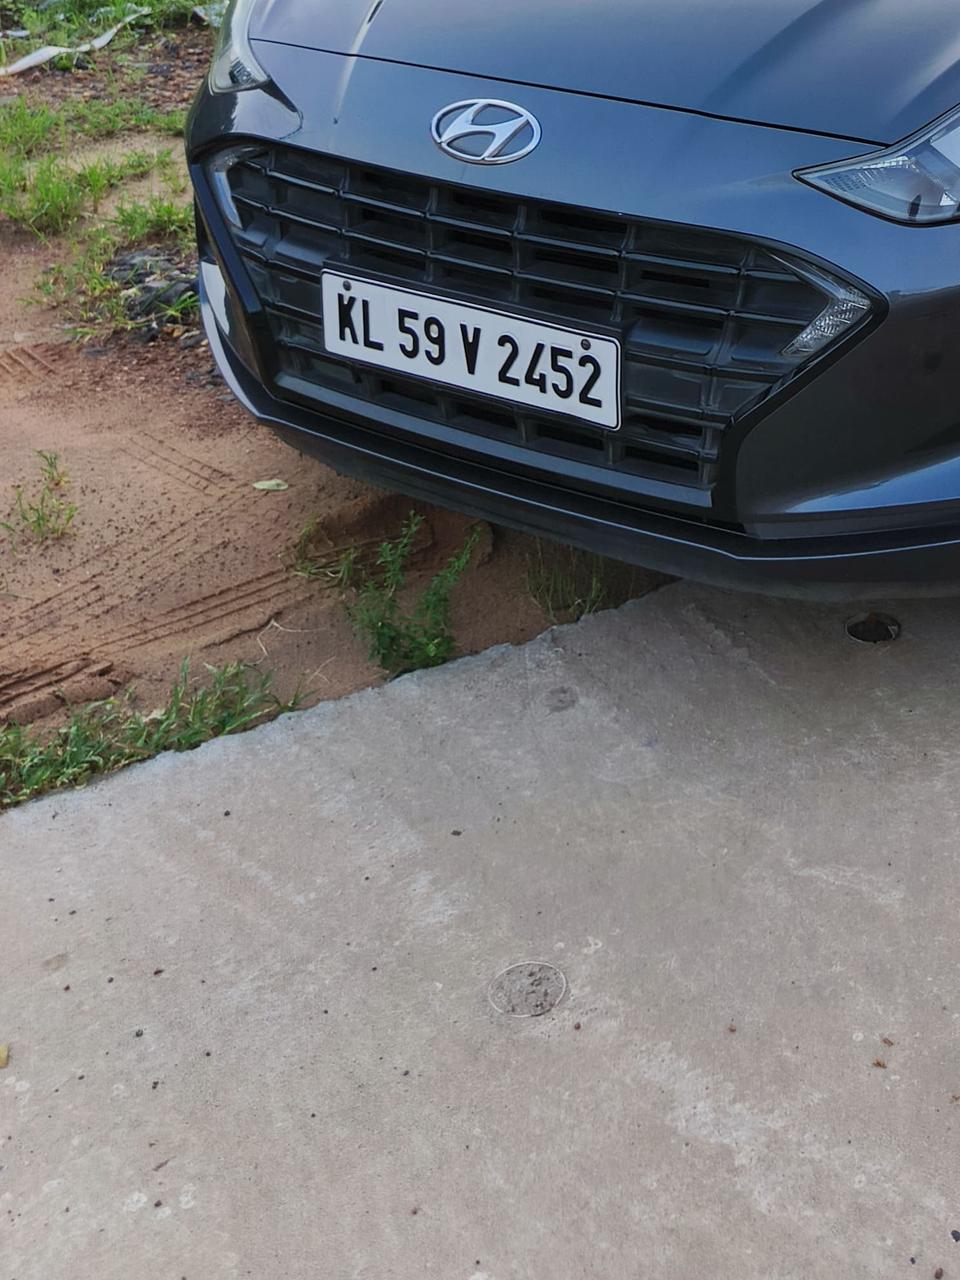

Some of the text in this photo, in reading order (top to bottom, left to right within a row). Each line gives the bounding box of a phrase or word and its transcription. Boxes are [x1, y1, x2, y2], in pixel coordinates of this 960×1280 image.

[337, 293, 602, 408] KL 59 V 2452
